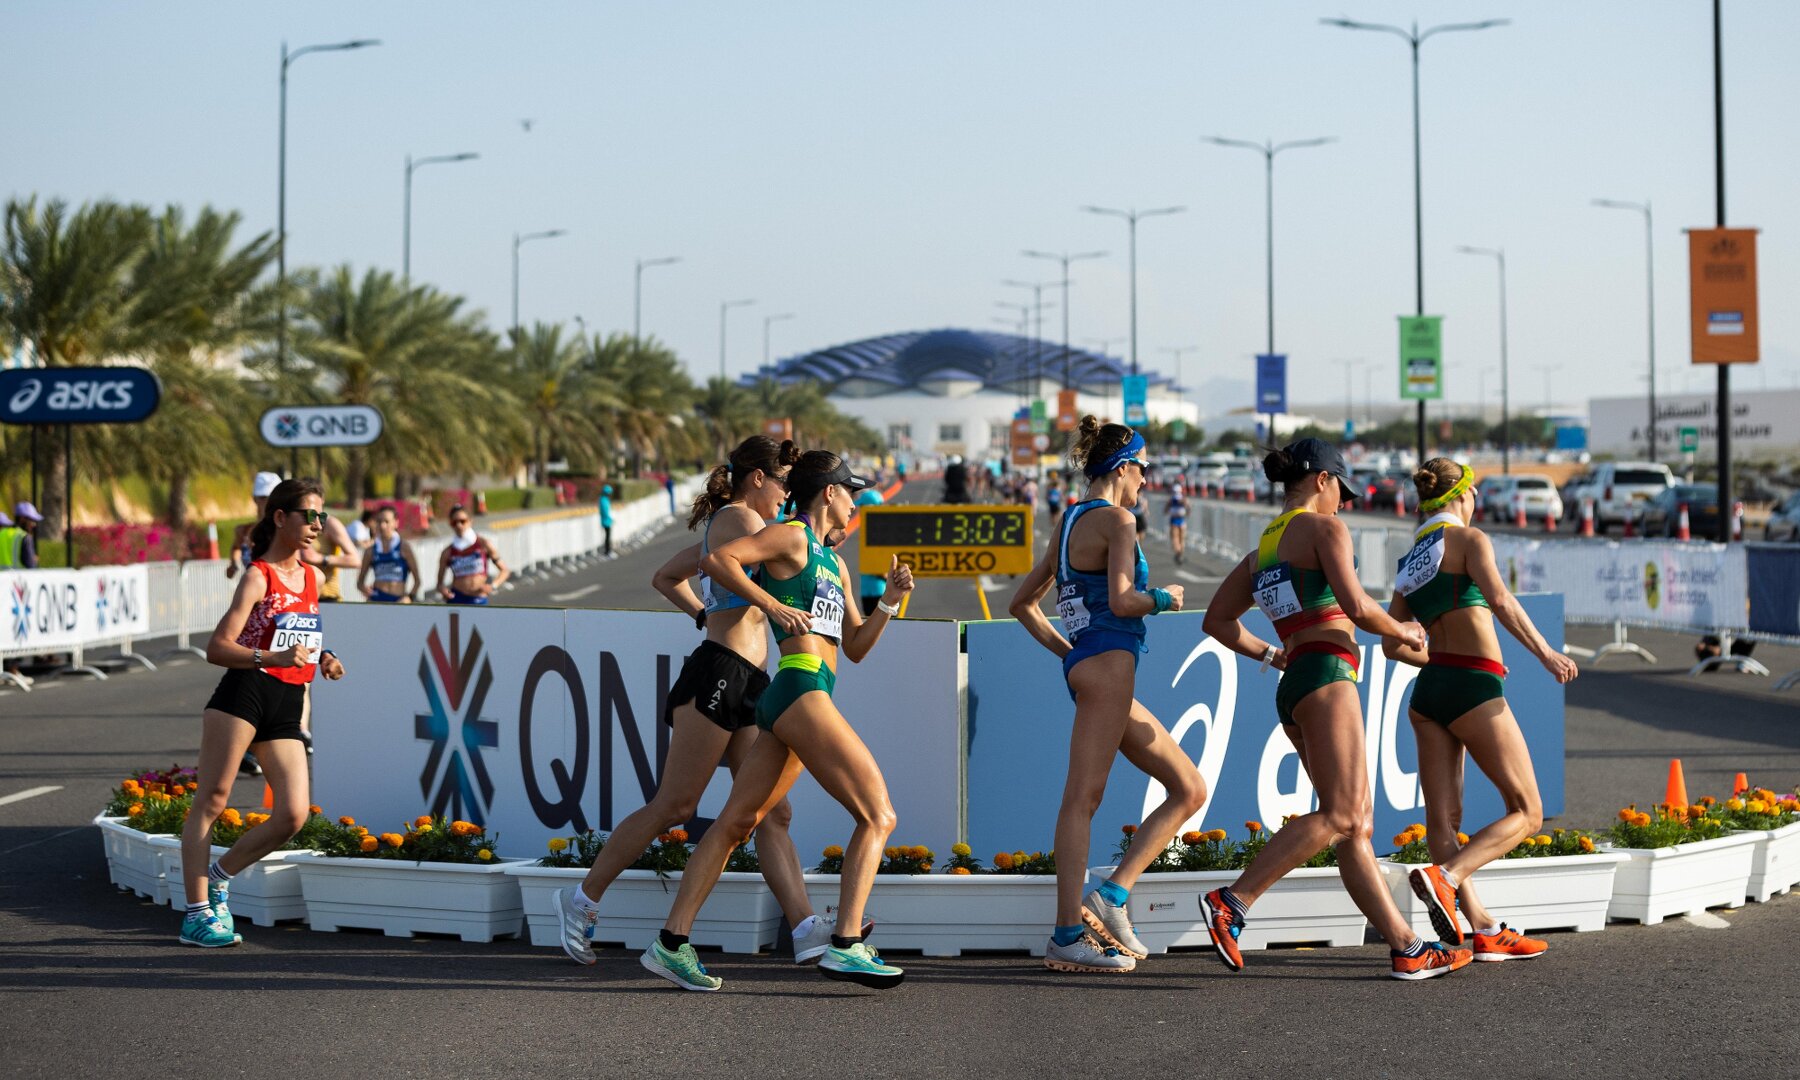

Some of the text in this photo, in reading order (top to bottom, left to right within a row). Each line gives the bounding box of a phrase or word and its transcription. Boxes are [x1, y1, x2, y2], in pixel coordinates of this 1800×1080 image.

[47, 380, 134, 410] asics
[307, 415, 368, 437] QNB
[897, 551, 996, 572] SEIKO
[1408, 551, 1431, 576] 568
[1262, 587, 1279, 607] 567
[36, 583, 78, 635] QNB
[296, 617, 317, 629] asics
[277, 631, 310, 648] DOST
